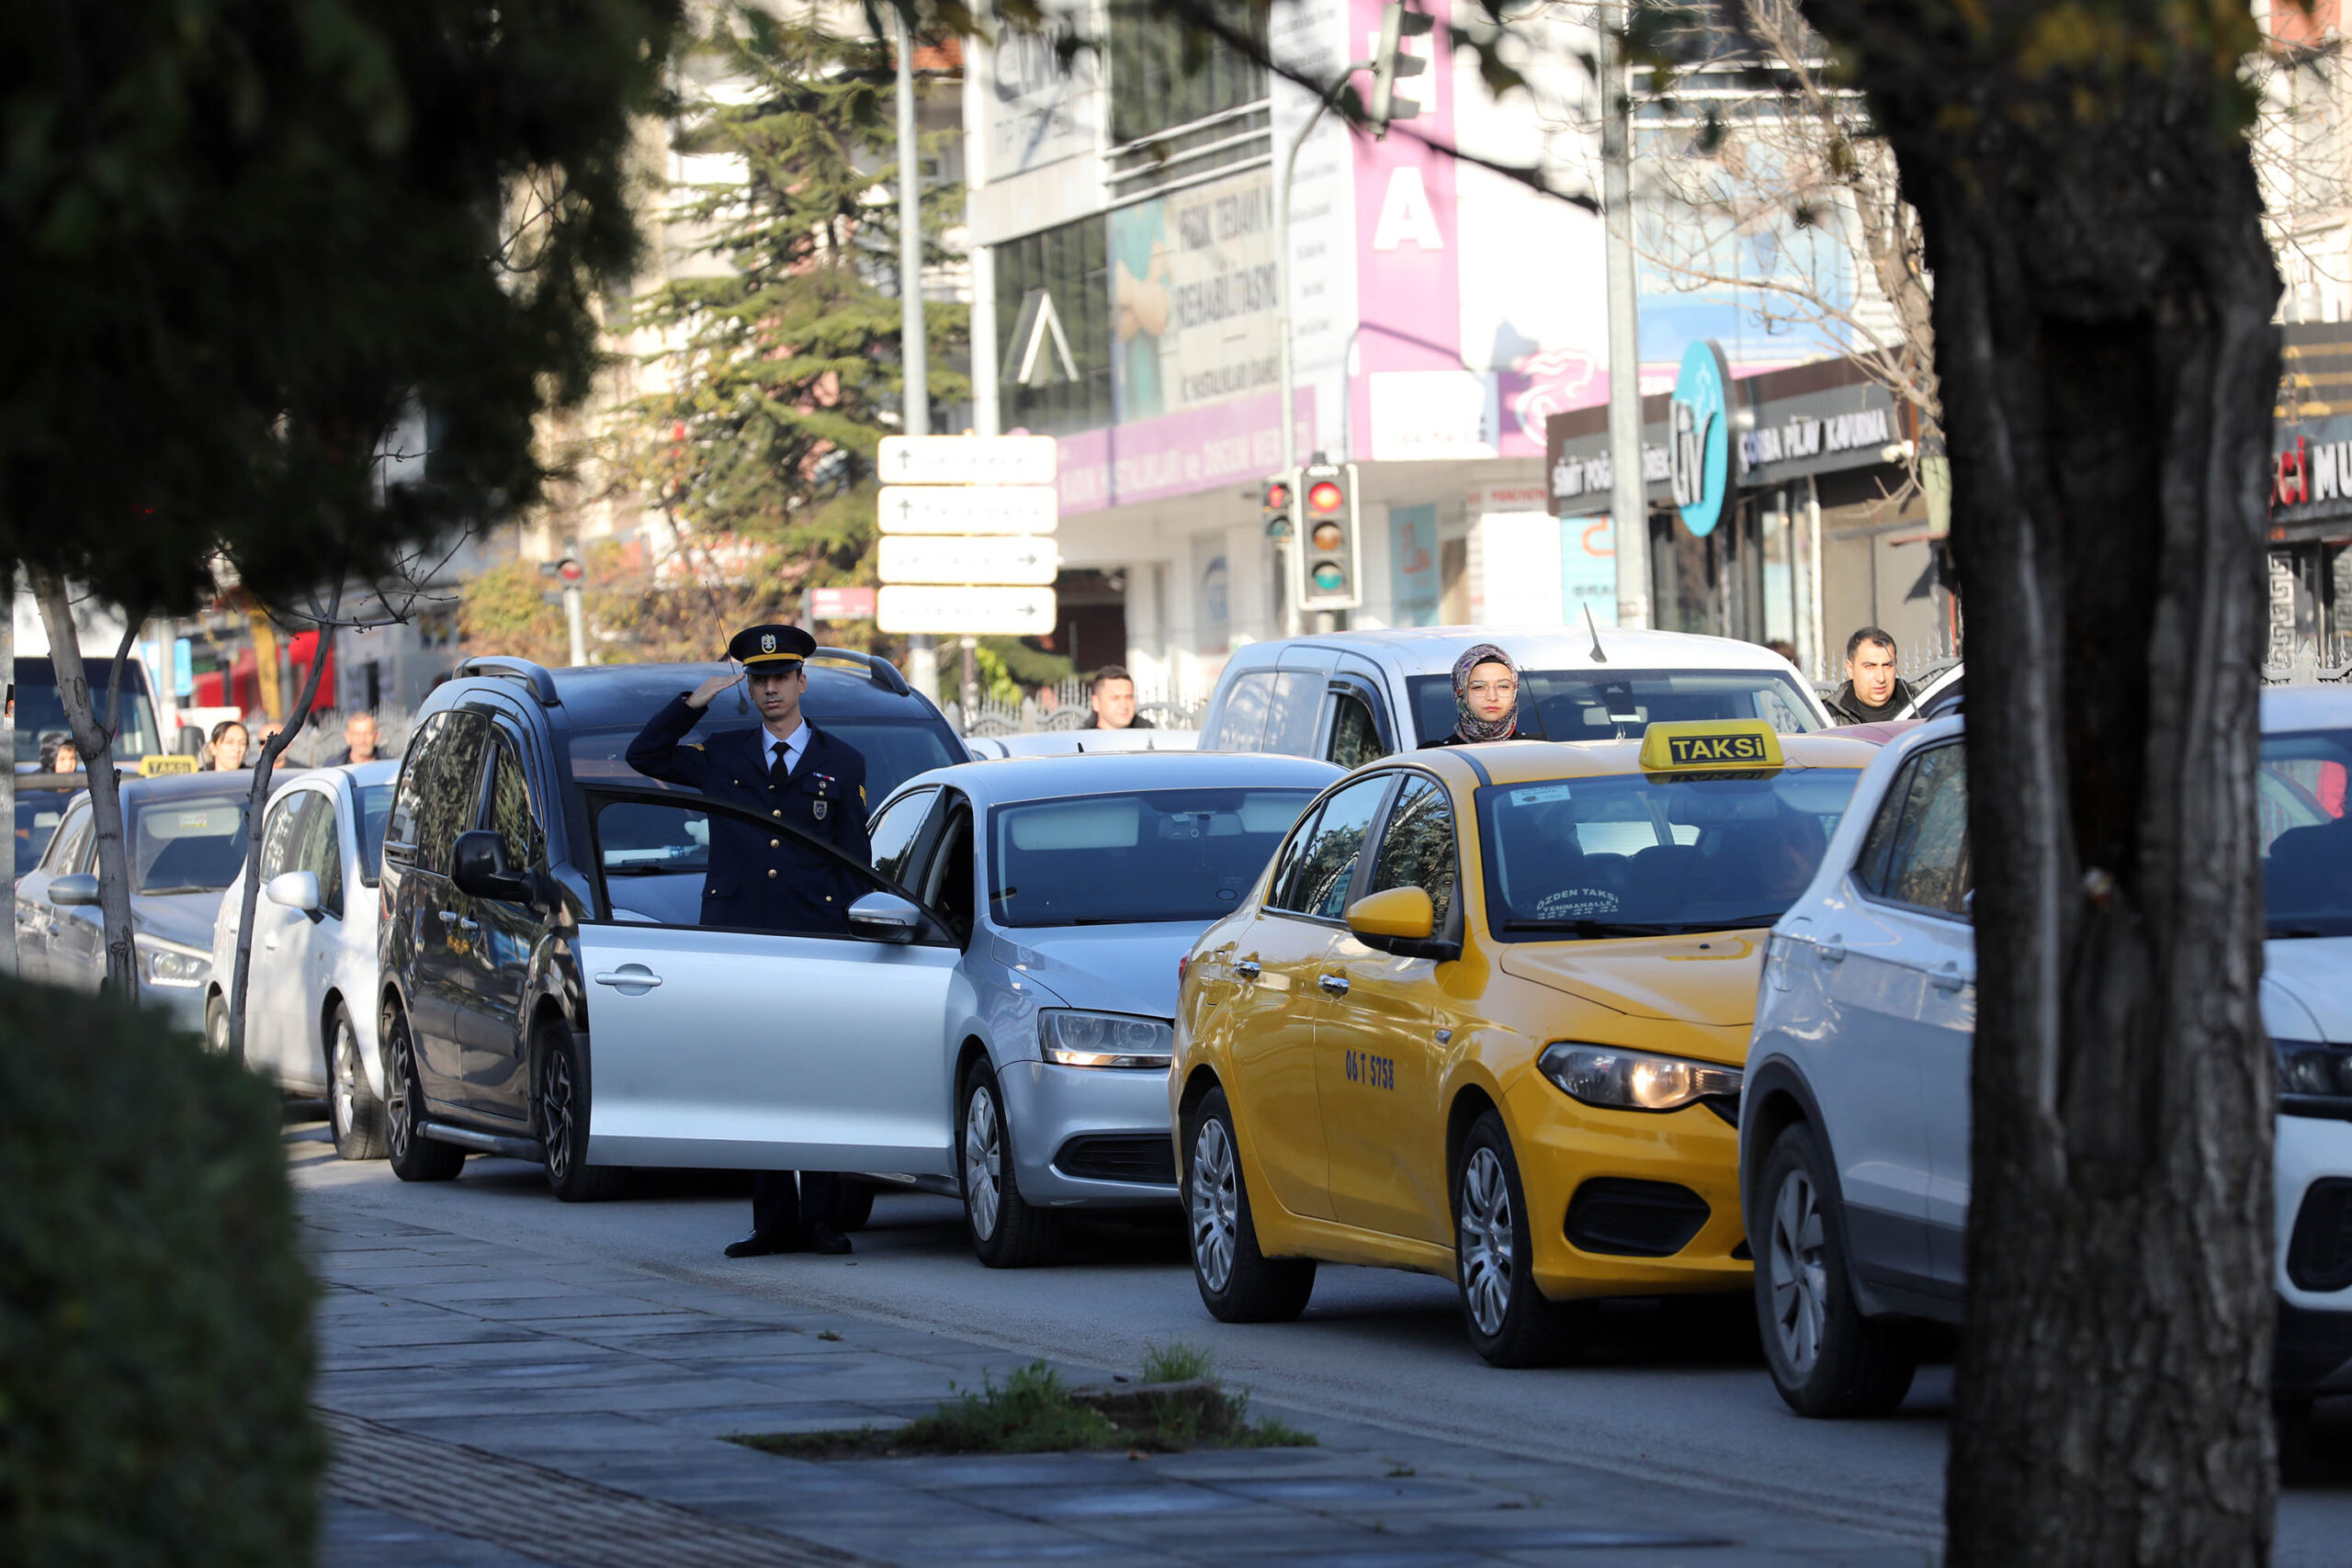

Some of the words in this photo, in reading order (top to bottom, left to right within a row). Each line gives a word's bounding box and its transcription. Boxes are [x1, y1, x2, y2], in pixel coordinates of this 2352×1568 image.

[1825, 408, 1889, 451] KAVURMA
[1536, 887, 1578, 911] ÖZDEN
[1345, 1049, 1358, 1082] 06
[1360, 1053, 1366, 1084] T
[1370, 1055, 1395, 1091] 5758
